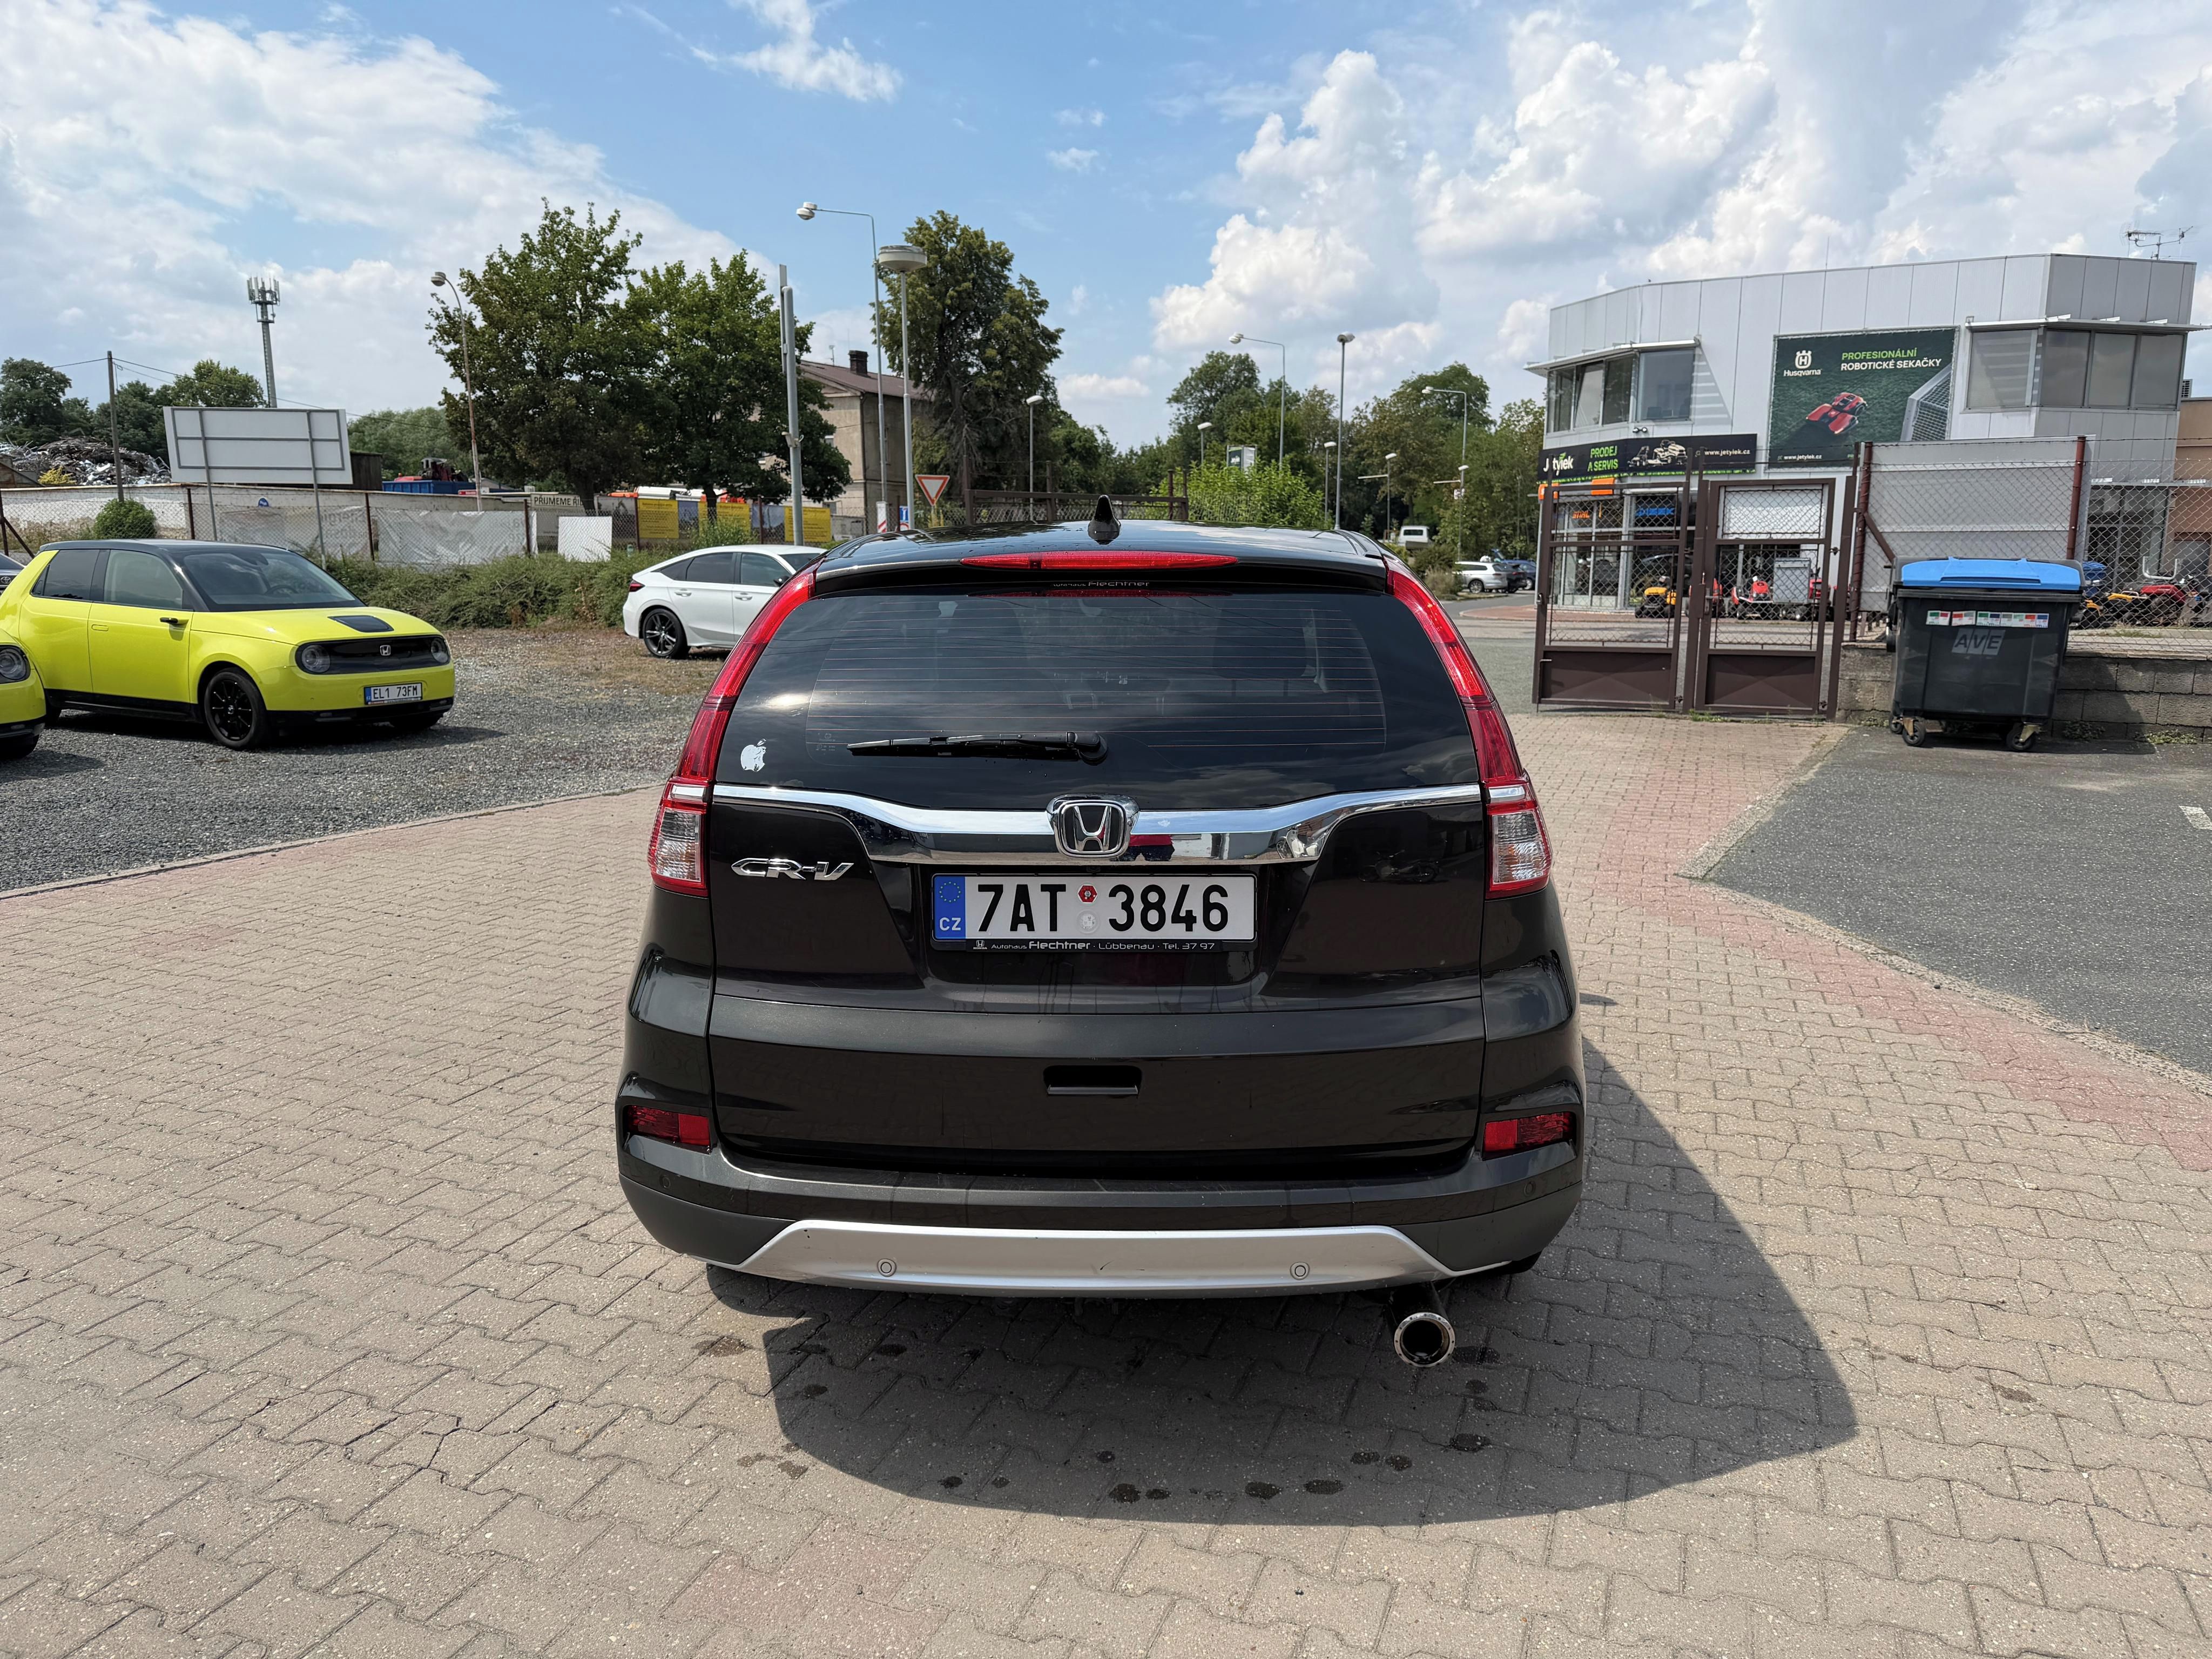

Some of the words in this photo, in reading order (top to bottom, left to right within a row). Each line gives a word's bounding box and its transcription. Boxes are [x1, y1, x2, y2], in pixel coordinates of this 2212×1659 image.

[1842, 347, 1917, 360] PROFESIONÁLNÍ
[1840, 359, 1895, 371] ROBOTICKÉ
[1896, 357, 1942, 368] SEKAČKY
[1590, 445, 1617, 458] PRODEJ
[1543, 455, 1574, 476] Jtylek
[1587, 461, 1593, 472] A
[1594, 458, 1618, 471] SERVIS
[1954, 633, 2002, 650] AVE
[373, 687, 389, 699] EL1
[396, 685, 417, 697] 73FM
[731, 858, 854, 880] CR-V
[977, 884, 1067, 932] 7AT
[1108, 884, 1229, 932] 3846
[940, 917, 961, 931] CZ
[1029, 941, 1091, 949] Flechtner
